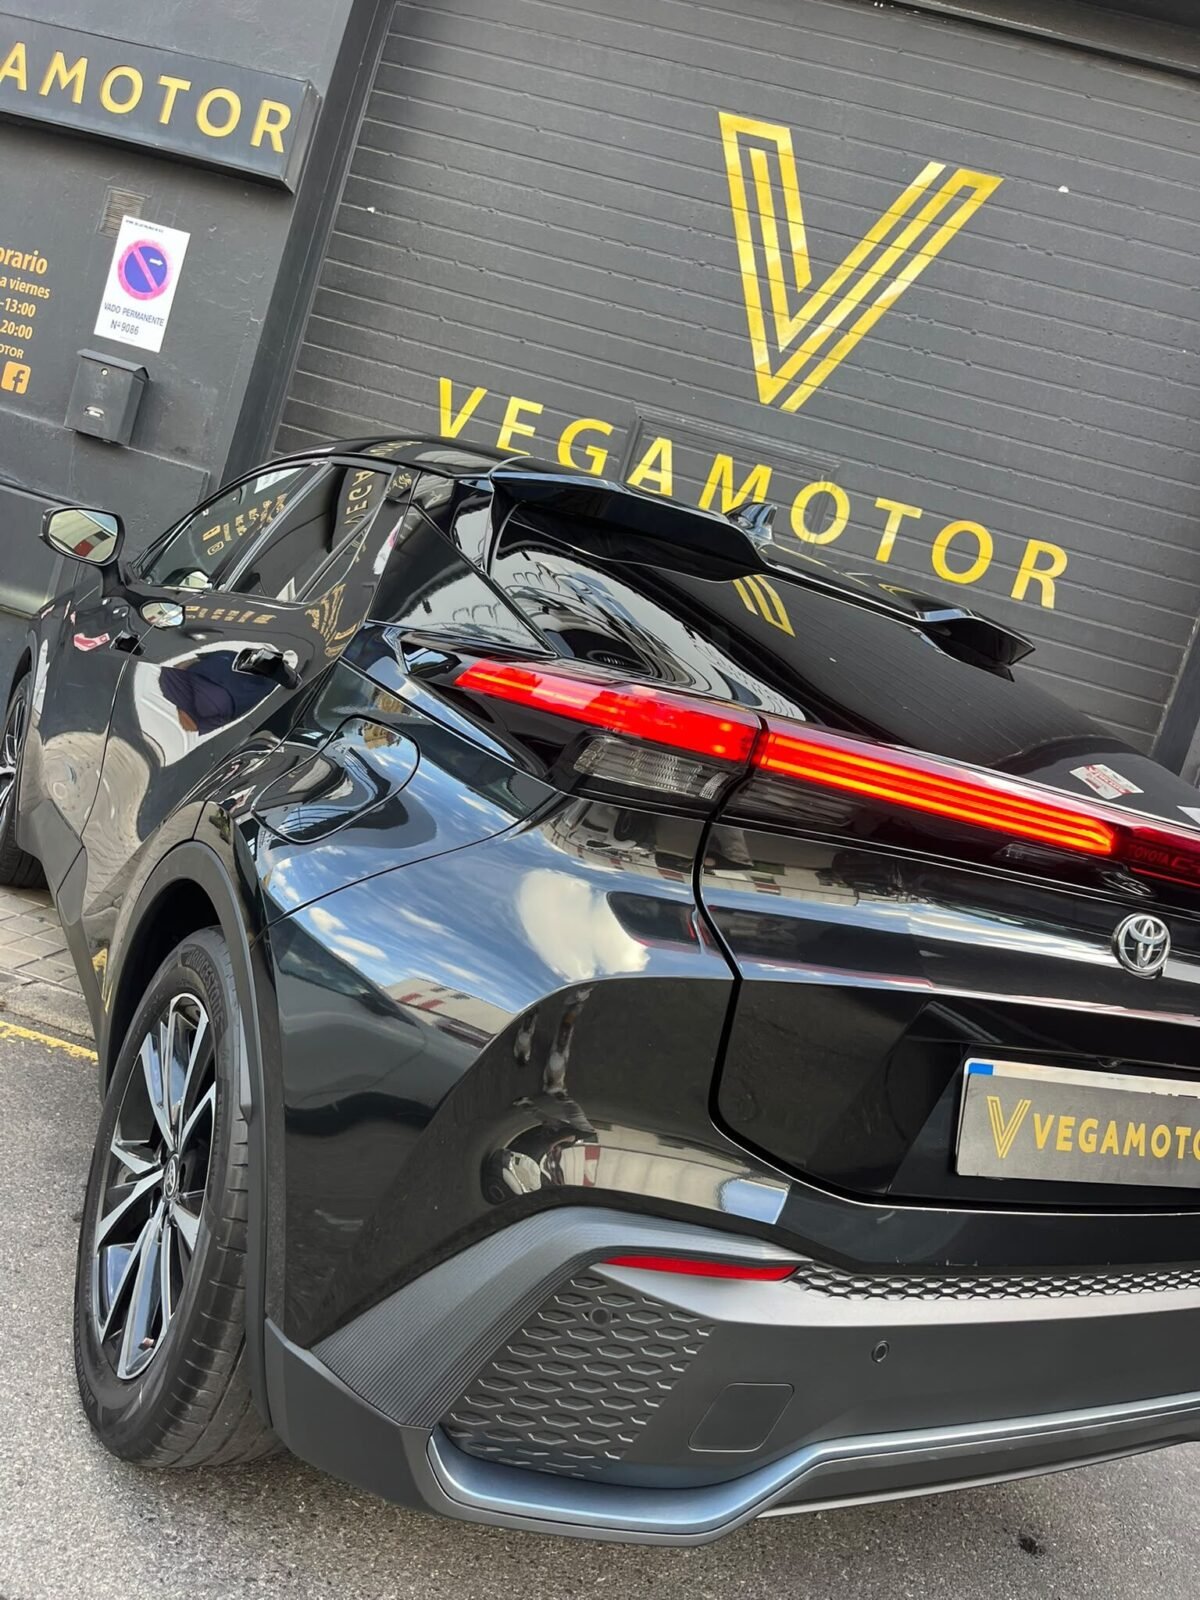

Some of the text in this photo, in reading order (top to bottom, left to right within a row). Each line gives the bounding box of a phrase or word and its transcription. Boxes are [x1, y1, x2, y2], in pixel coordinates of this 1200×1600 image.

[0, 41, 292, 153] AMOTOR
[9, 277, 51, 299] viernes
[104, 302, 165, 327] VADO PERMANENTE
[438, 376, 1068, 609] VEGAMOTOR
